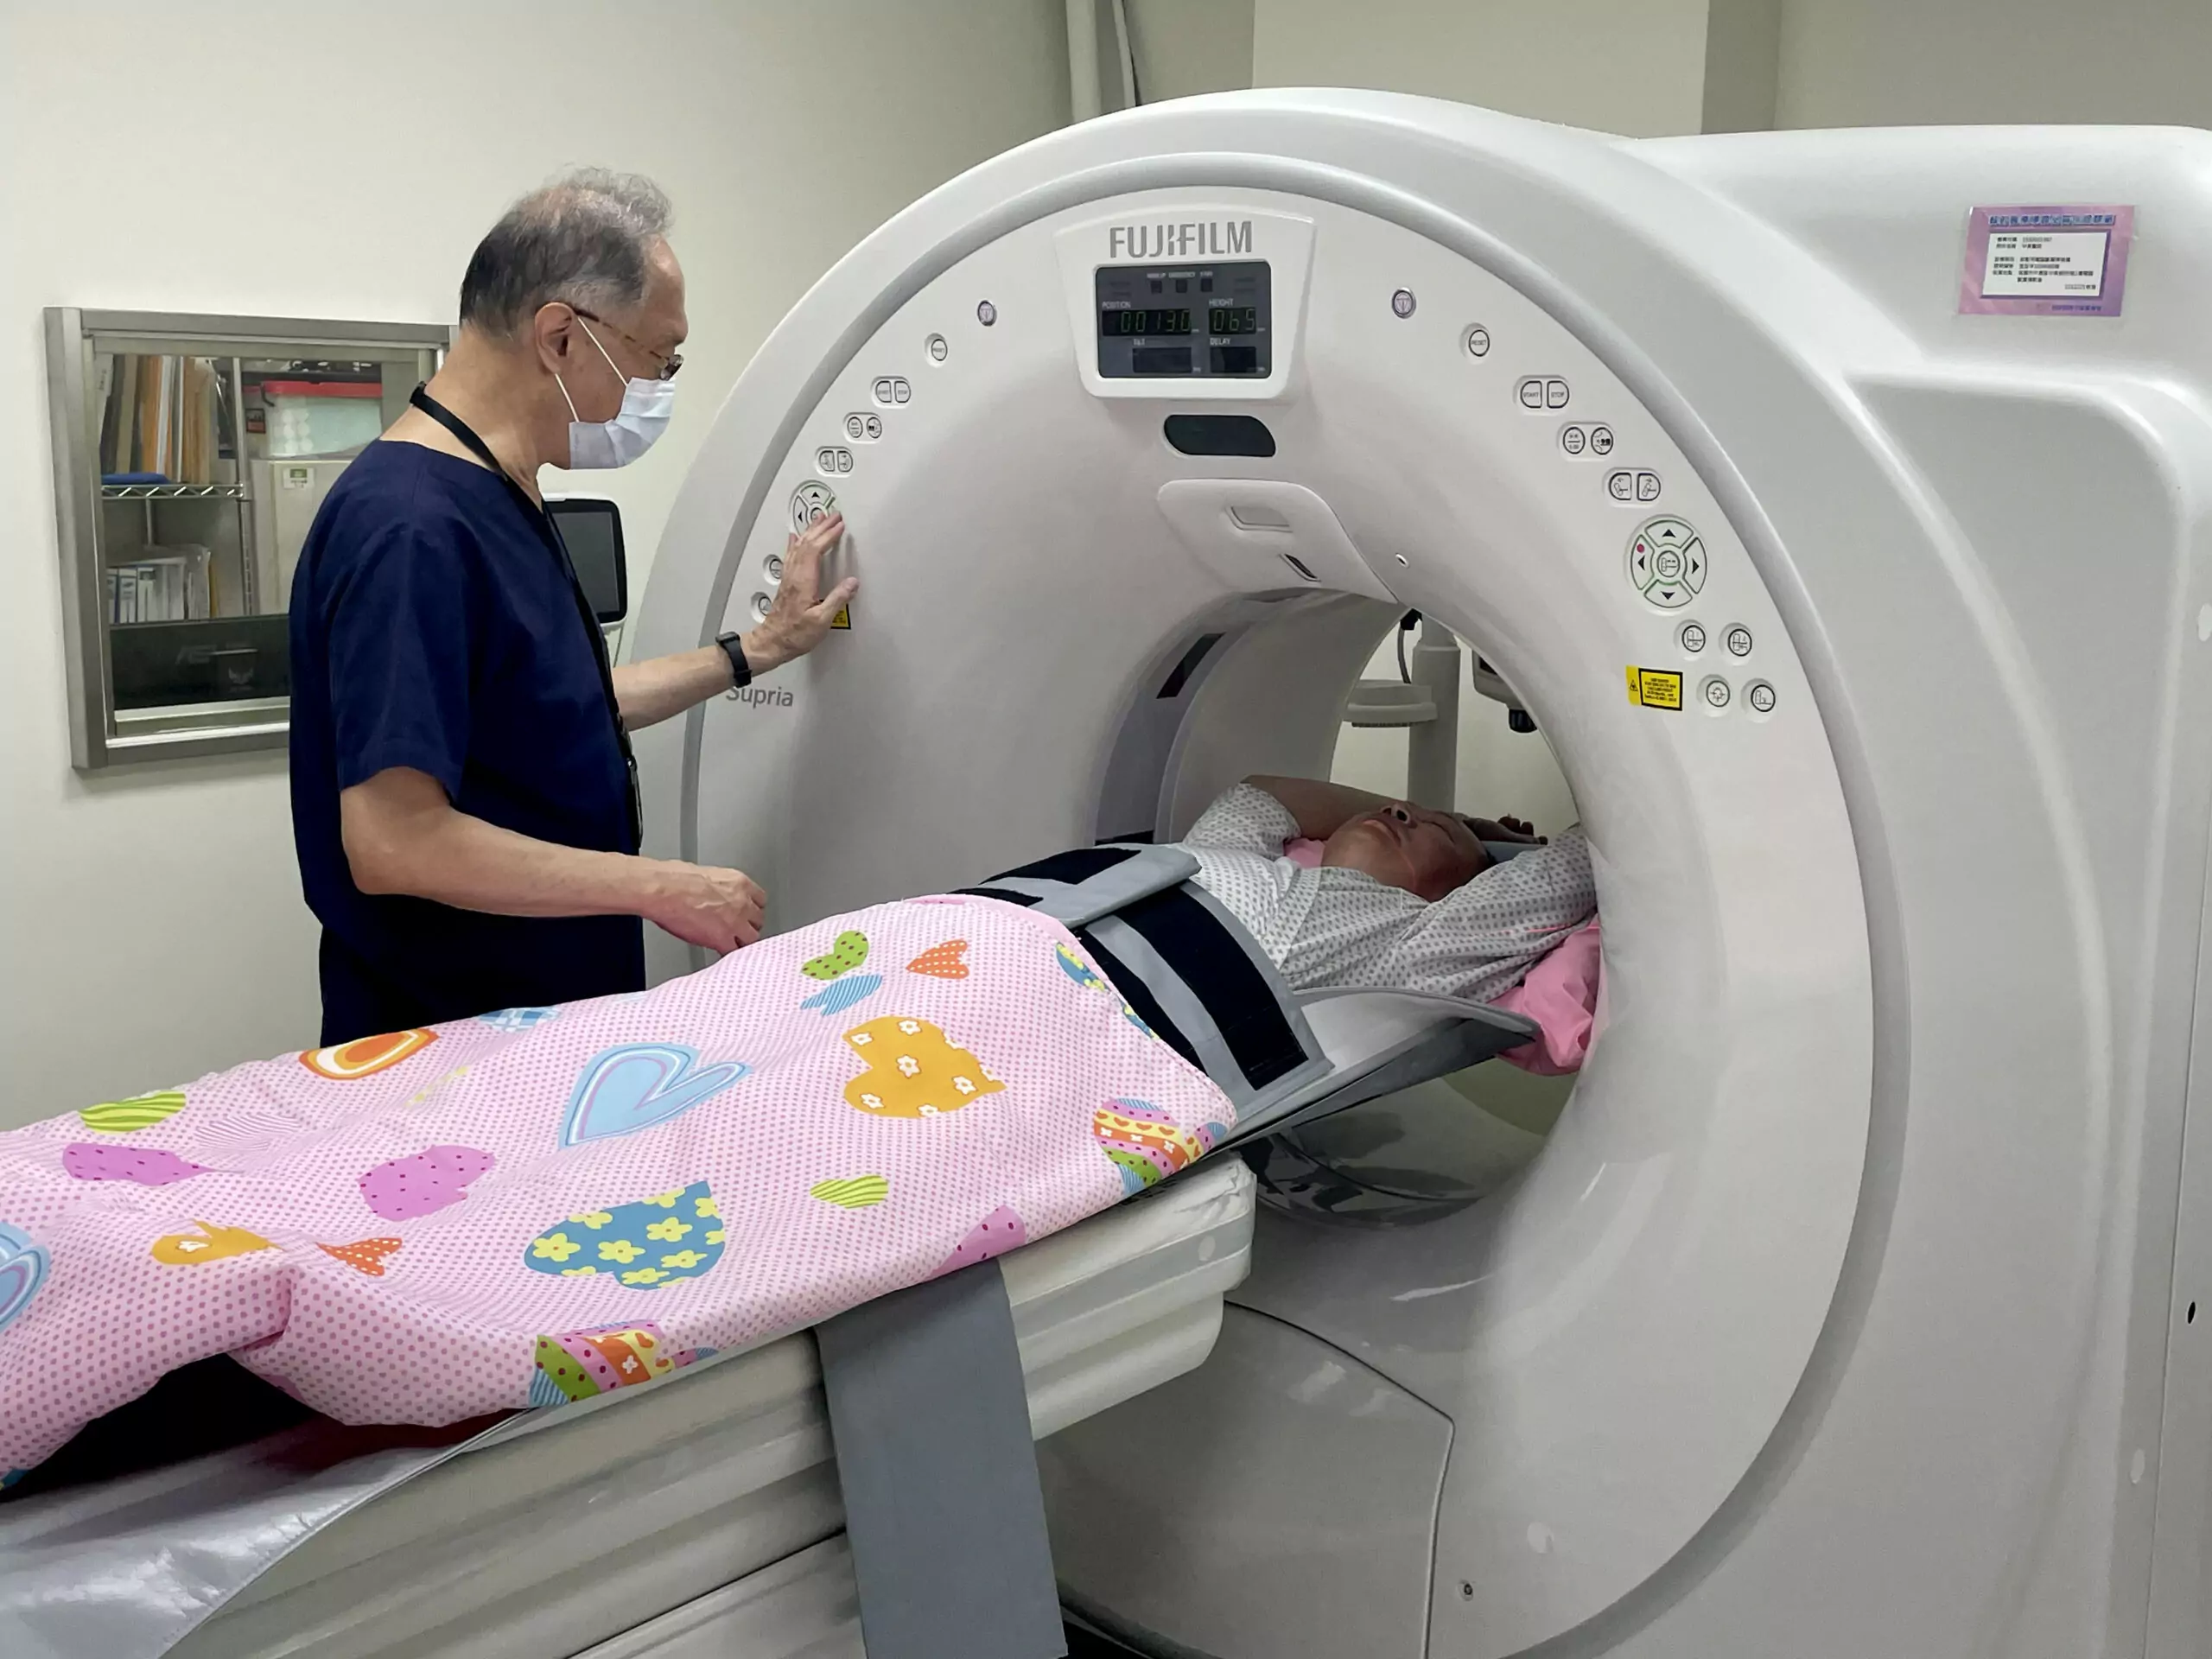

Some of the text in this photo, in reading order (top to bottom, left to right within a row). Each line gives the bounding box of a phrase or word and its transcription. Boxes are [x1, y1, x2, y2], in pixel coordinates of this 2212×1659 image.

[1109, 220, 1252, 258] FUJIFILM
[1209, 298, 1234, 307] HEIGHT
[1210, 337, 1231, 346] DELAY
[726, 686, 793, 709] Supria
